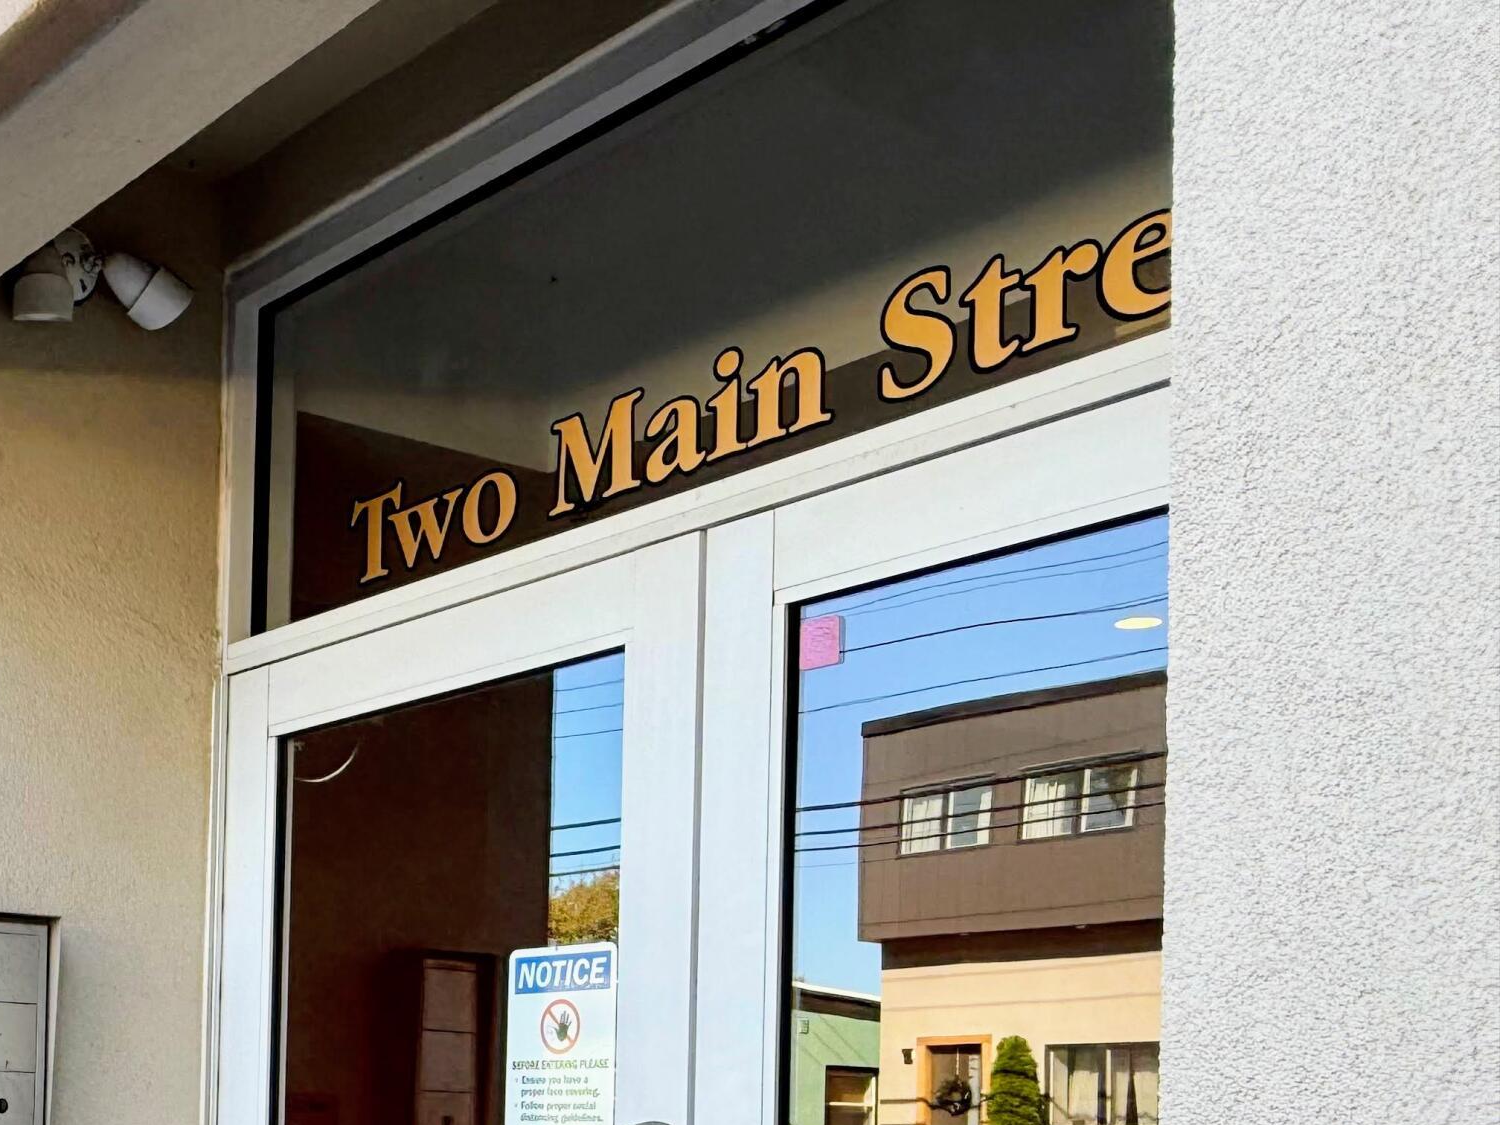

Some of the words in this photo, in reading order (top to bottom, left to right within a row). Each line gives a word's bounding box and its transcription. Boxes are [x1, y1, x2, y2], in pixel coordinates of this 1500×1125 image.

[351, 468, 520, 585] Two
[548, 346, 832, 519] Main
[518, 956, 607, 989] NOTICE
[579, 1058, 609, 1069] PLEASE
